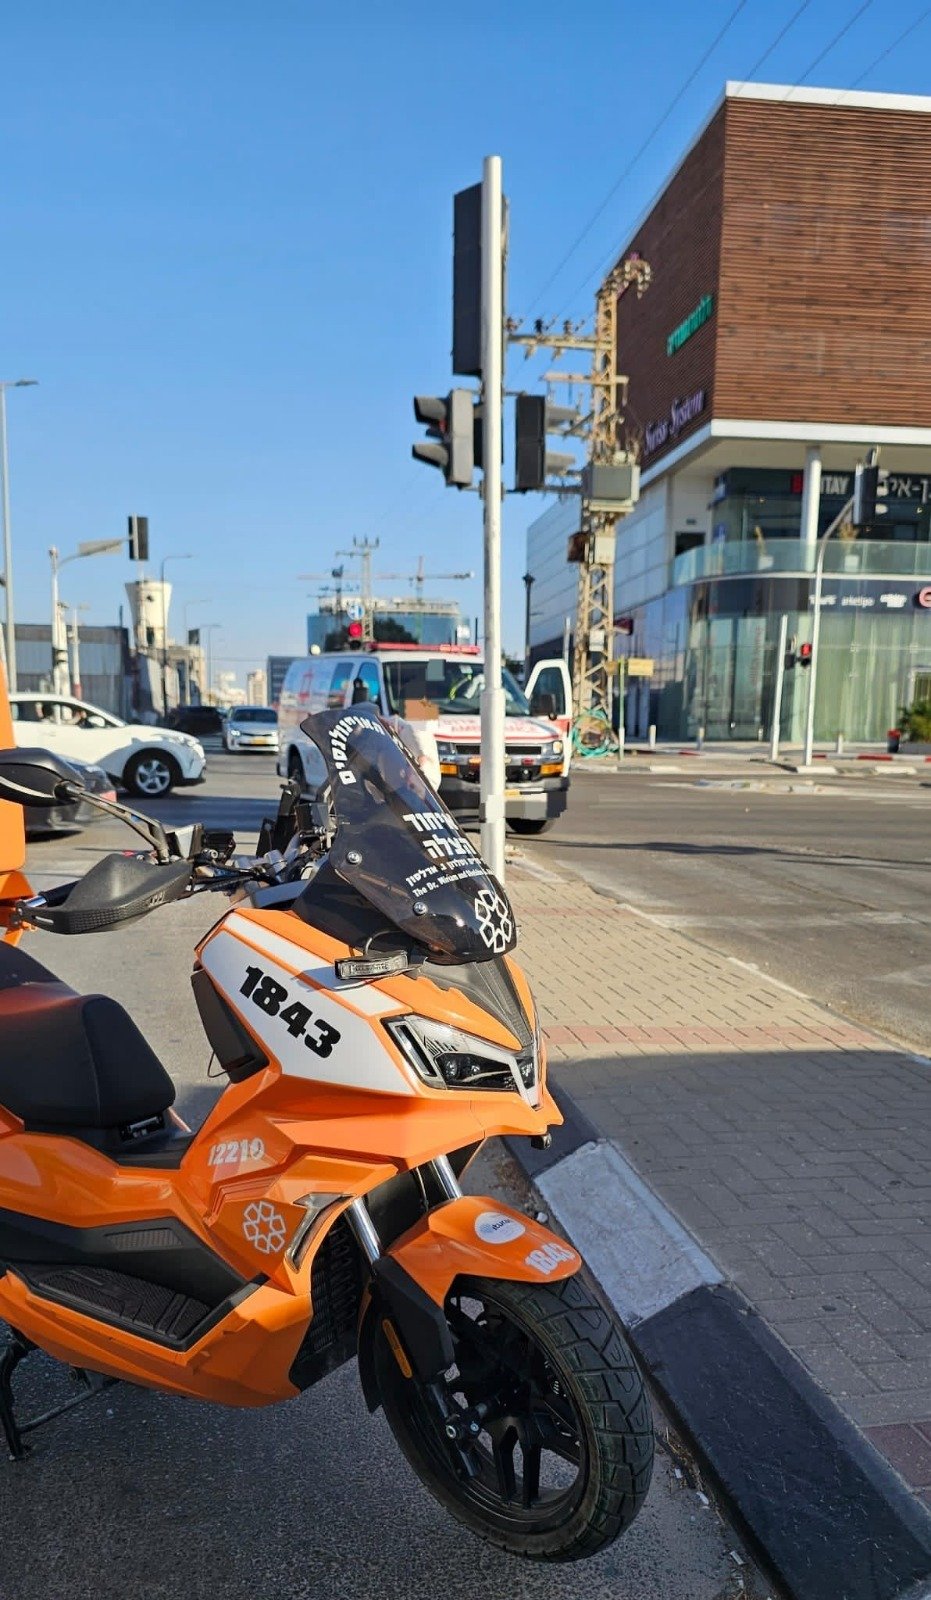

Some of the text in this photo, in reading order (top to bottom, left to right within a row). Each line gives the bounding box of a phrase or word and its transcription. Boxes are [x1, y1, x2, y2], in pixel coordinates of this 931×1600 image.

[422, 834, 477, 859] הצלה
[412, 886, 428, 898] The
[239, 964, 342, 1059] 1843
